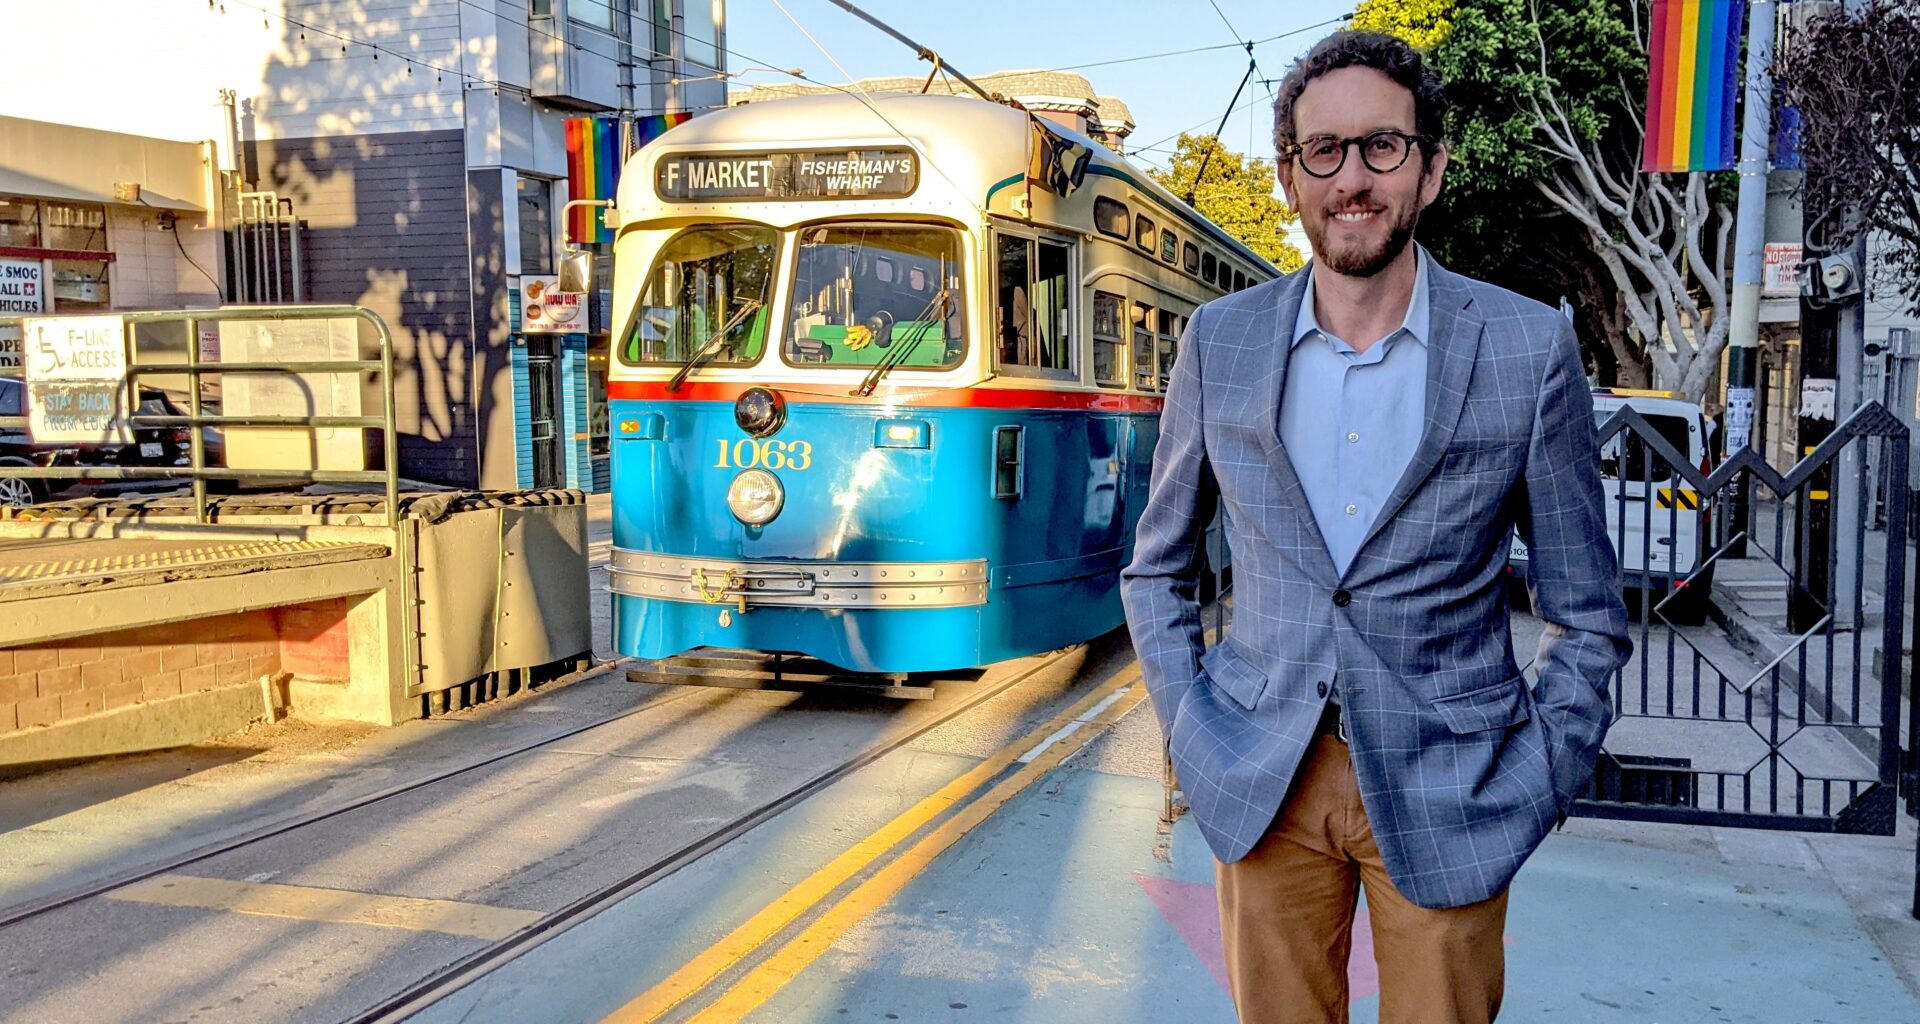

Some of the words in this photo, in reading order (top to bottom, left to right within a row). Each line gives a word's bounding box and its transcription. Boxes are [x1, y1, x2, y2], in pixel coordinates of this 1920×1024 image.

[667, 162, 680, 189] F
[688, 160, 773, 189] MARKET
[800, 159, 911, 176] FISHERMAN'S
[826, 175, 884, 190] WHARF
[1766, 251, 1779, 263] NO
[6, 265, 38, 280] SMOG
[1, 282, 21, 296] ALL
[0, 299, 38, 313] HICLES
[71, 350, 117, 367] ACCESS
[46, 392, 72, 411] STAY
[79, 392, 110, 411] BACK
[44, 414, 77, 431] FROM
[83, 414, 115, 431] EDGE
[713, 438, 812, 471] 1063
